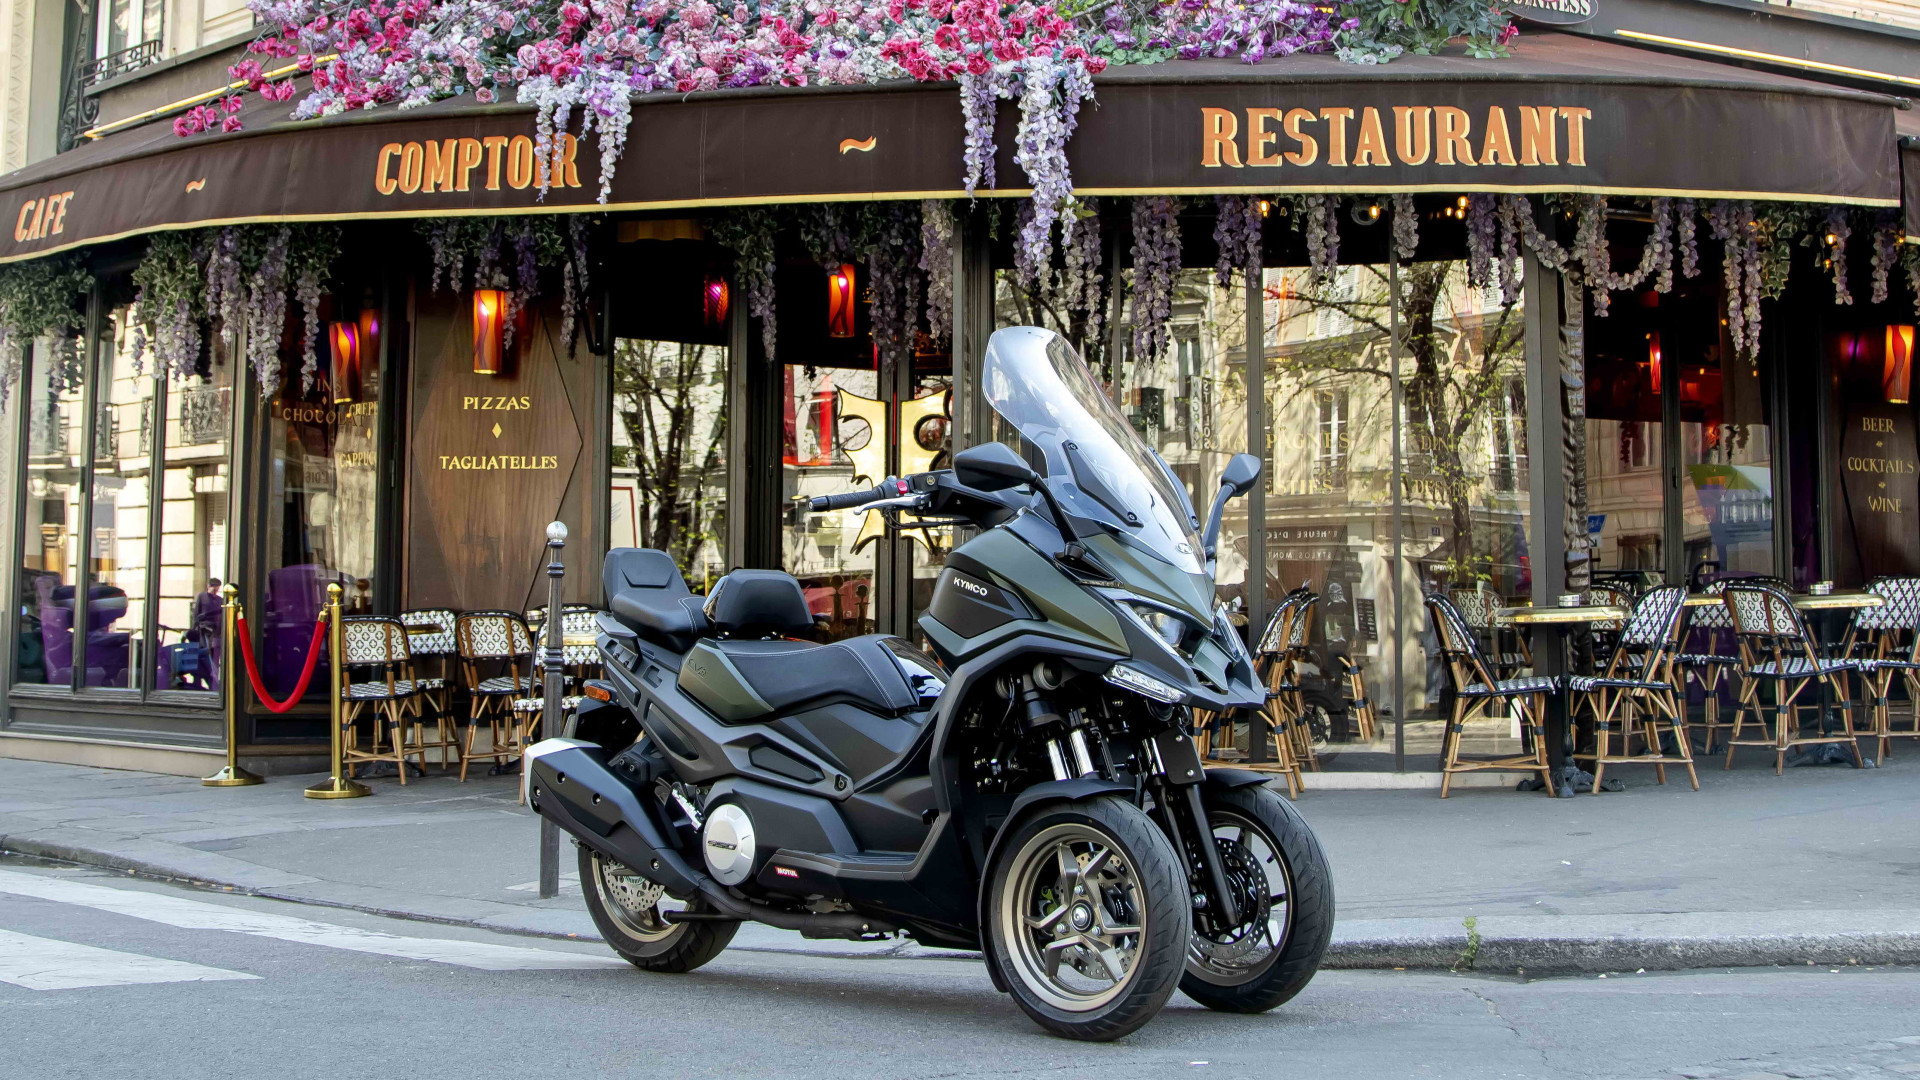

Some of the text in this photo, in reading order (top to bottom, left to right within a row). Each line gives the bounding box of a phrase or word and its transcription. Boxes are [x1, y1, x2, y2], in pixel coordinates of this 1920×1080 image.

[1201, 105, 1592, 168] RESTAURANT
[375, 132, 582, 196] COMPTOIR
[14, 190, 75, 242] CAFE
[463, 396, 531, 411] PIZZAS
[1863, 417, 1895, 433] BEER
[439, 455, 558, 470] TAGLIATELLES
[1847, 457, 1914, 474] COCKTAILS
[1868, 496, 1901, 513] WINE
[953, 577, 988, 596] KYMCO
[776, 867, 798, 877] MOTUL
